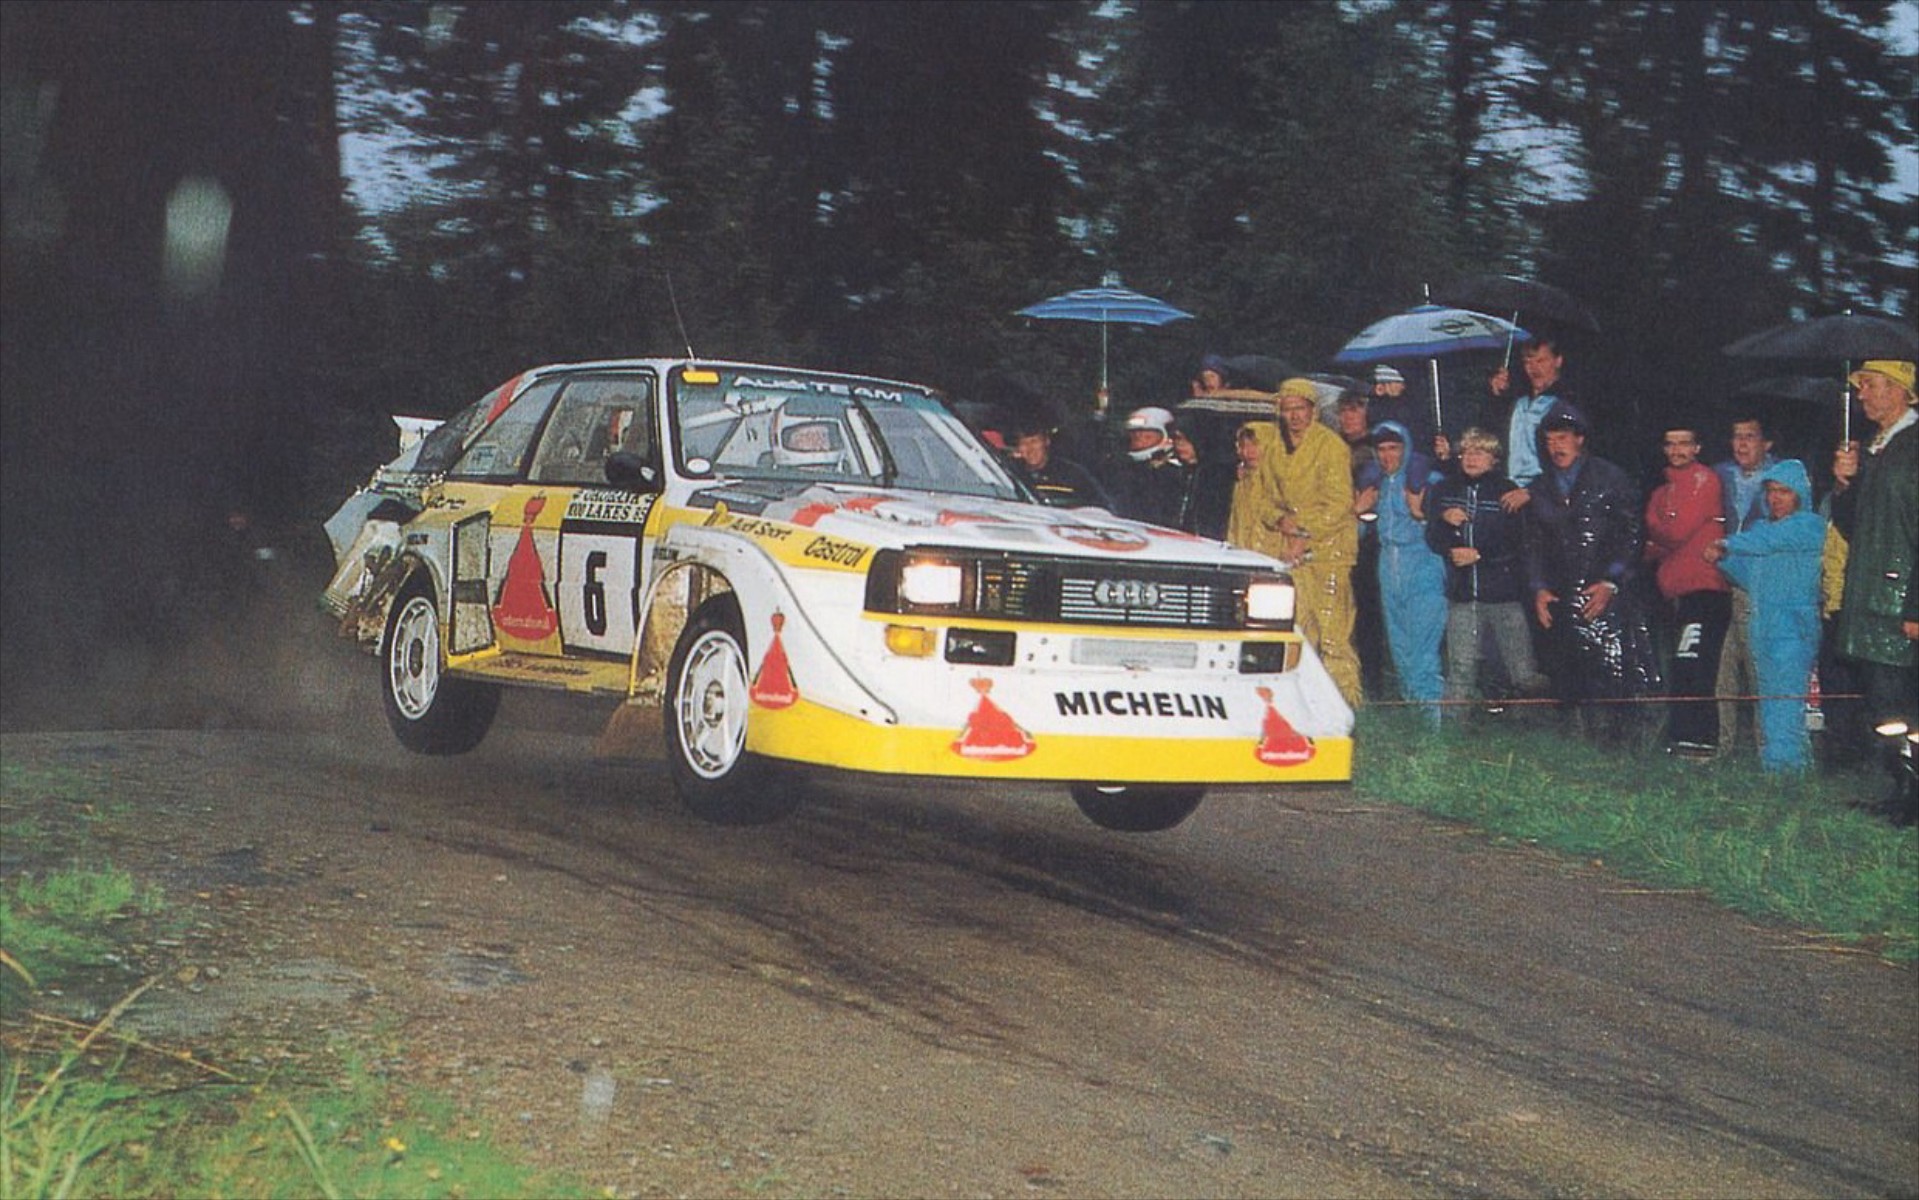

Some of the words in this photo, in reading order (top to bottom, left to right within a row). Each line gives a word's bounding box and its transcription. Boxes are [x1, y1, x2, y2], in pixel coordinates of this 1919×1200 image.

[810, 381, 902, 402] TEAM
[585, 503, 631, 520] LAKES
[804, 536, 868, 568] Castrol
[583, 551, 607, 637] 6
[1054, 691, 1228, 720] MICHELIN
